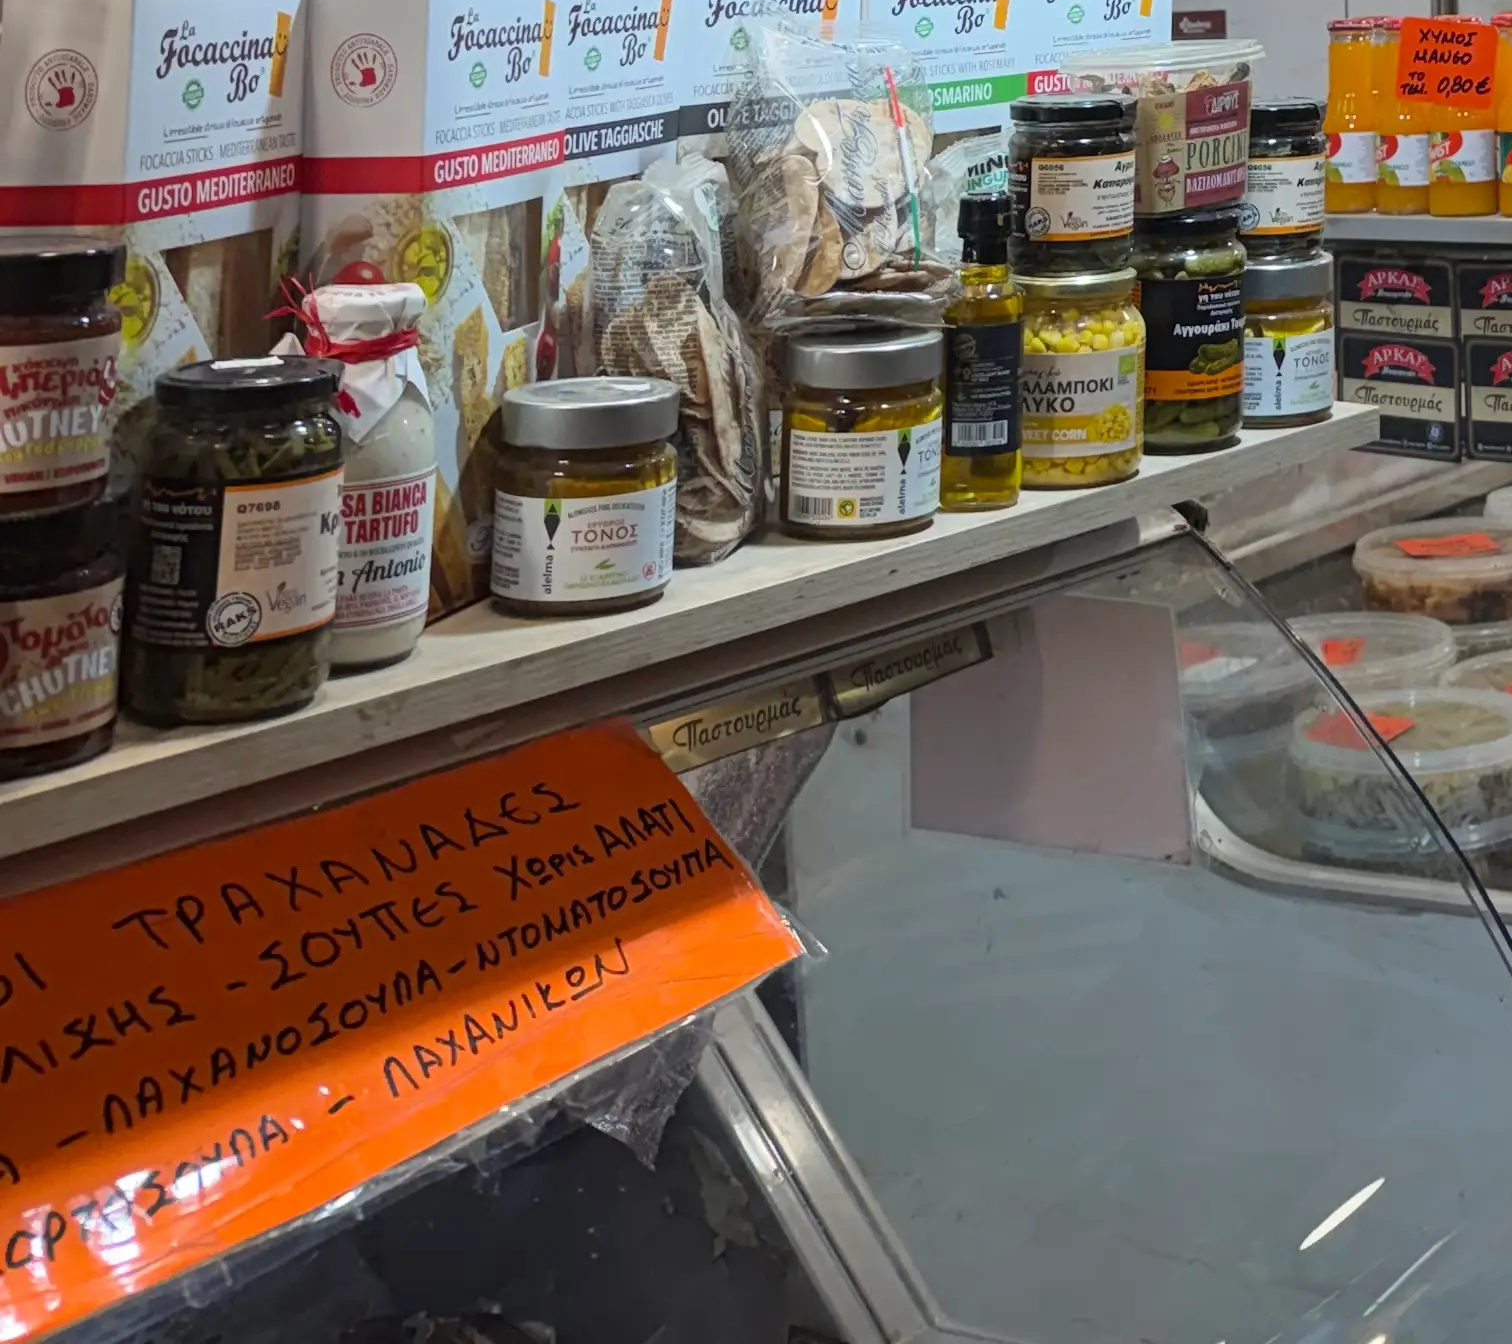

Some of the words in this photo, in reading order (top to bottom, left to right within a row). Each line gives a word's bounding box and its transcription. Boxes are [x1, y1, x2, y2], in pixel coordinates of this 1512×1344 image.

[448, 16, 543, 62] Focaccina
[568, 4, 659, 46] Focaccina
[156, 29, 274, 80] Focaccina
[1408, 70, 1426, 81] ΤΟ
[139, 151, 185, 172] FOCACCIA
[187, 145, 214, 165] STICKS
[564, 132, 598, 157] OLIVE
[600, 119, 664, 150] TAGGIASCHE
[434, 153, 478, 184] GUSTO
[481, 137, 560, 175] MEDITERRANEO
[138, 181, 193, 214] GUSTO
[196, 163, 296, 205] MEDITERRANEO
[1173, 320, 1230, 338] Αγγουράκι
[1353, 309, 1440, 333] Παστουρμάς
[1355, 385, 1443, 414] Παστουρμάς
[0, 403, 104, 453] UTNEY
[1052, 427, 1088, 441] CORN
[372, 480, 428, 516] BIANCA
[344, 509, 419, 545] TARTUFO
[571, 524, 639, 545] ΤΟΝΟΣ
[352, 550, 427, 594] Antonio
[673, 688, 803, 752] Παστουρμάς
[593, 797, 696, 859] ΑΛΑΤΙ
[111, 781, 581, 950] ΤΡΑΧΑΝΑΔΕΣ
[0, 1114, 289, 1275] ΟΡΤΟΣΟΥΠΑ
[382, 936, 630, 1100] ΛΑΧΑΝΙΚΩΝ
